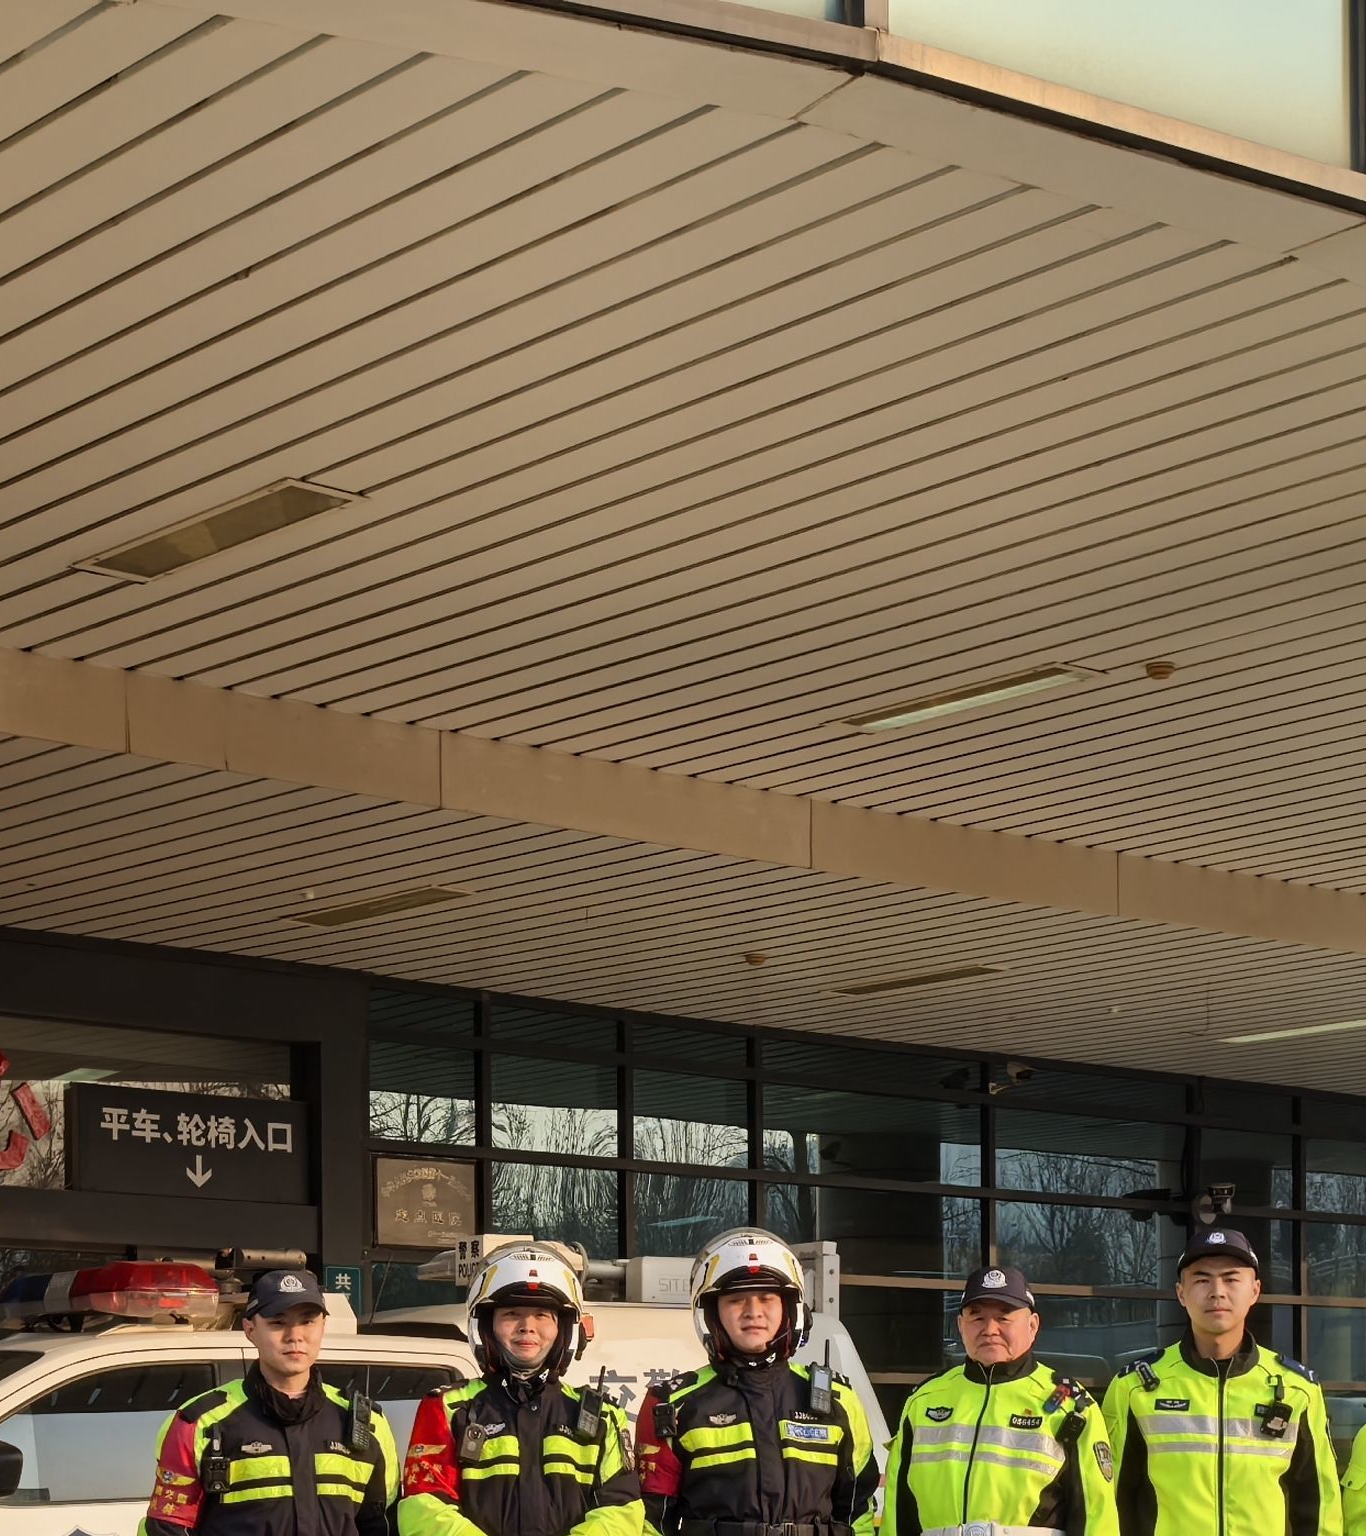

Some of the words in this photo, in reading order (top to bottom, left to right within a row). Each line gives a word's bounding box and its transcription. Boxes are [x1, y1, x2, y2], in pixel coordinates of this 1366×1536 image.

[100, 1107, 293, 1153] 平车、轮椅入口
[459, 1241, 480, 1260] 警察
